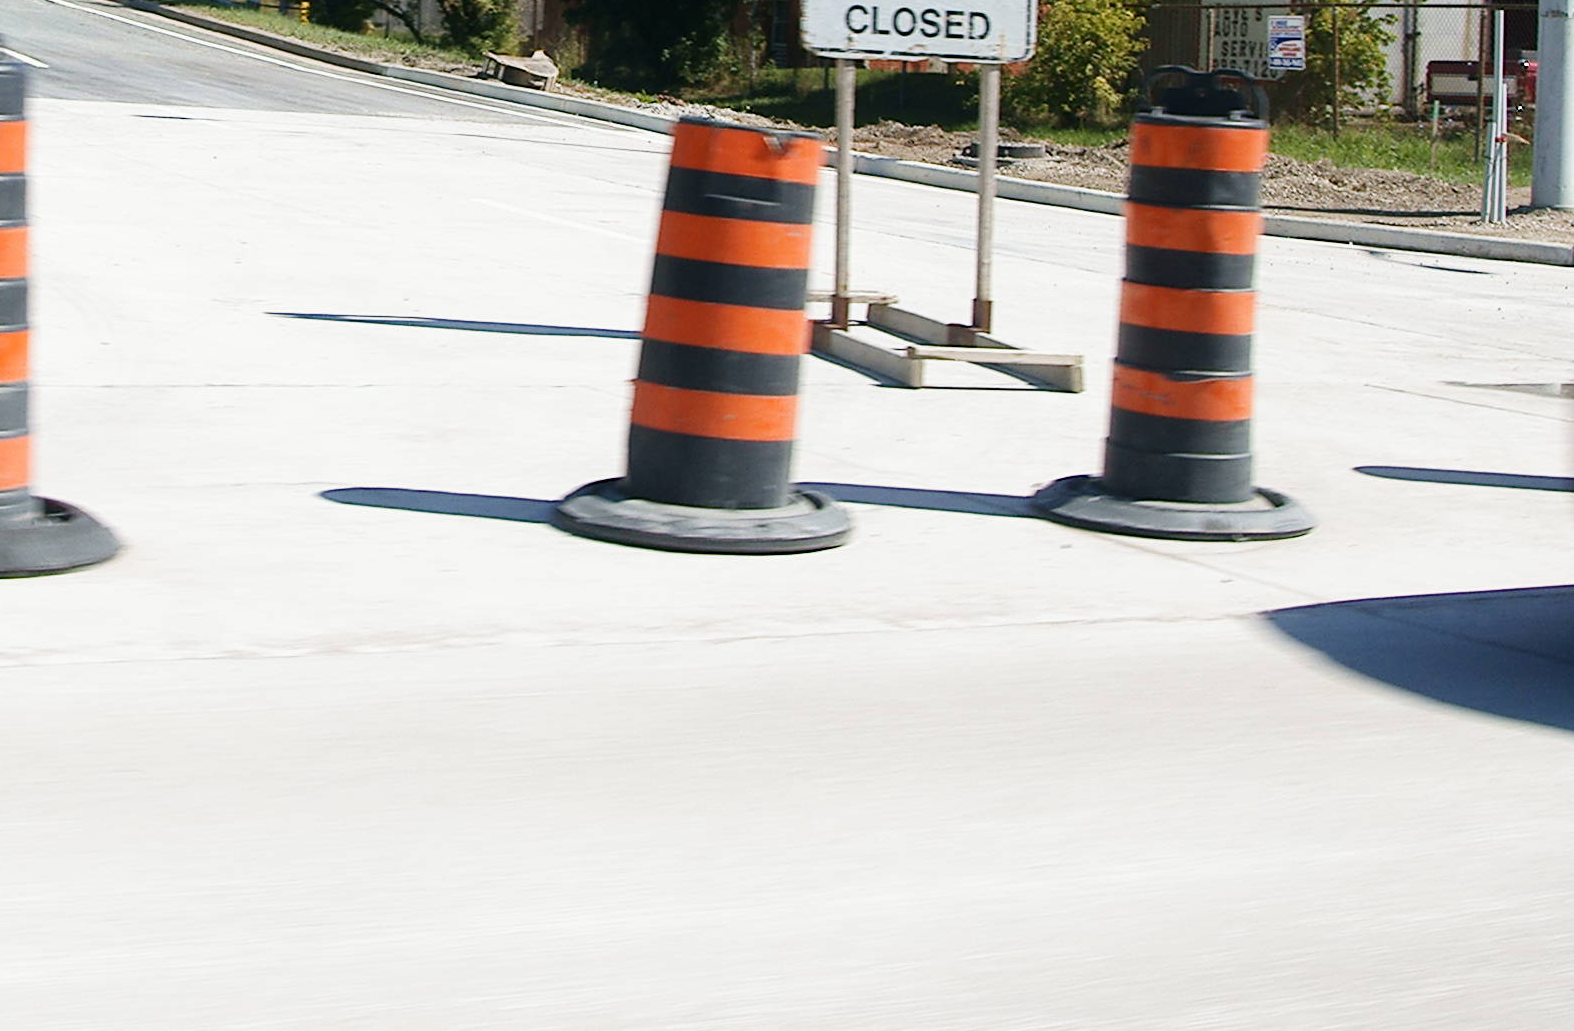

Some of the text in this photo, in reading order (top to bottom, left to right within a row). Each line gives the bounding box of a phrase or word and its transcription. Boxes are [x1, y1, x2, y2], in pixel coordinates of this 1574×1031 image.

[845, 4, 991, 40] CLOSED
[1213, 20, 1249, 38] AUTO
[1221, 40, 1269, 58] SERVI
